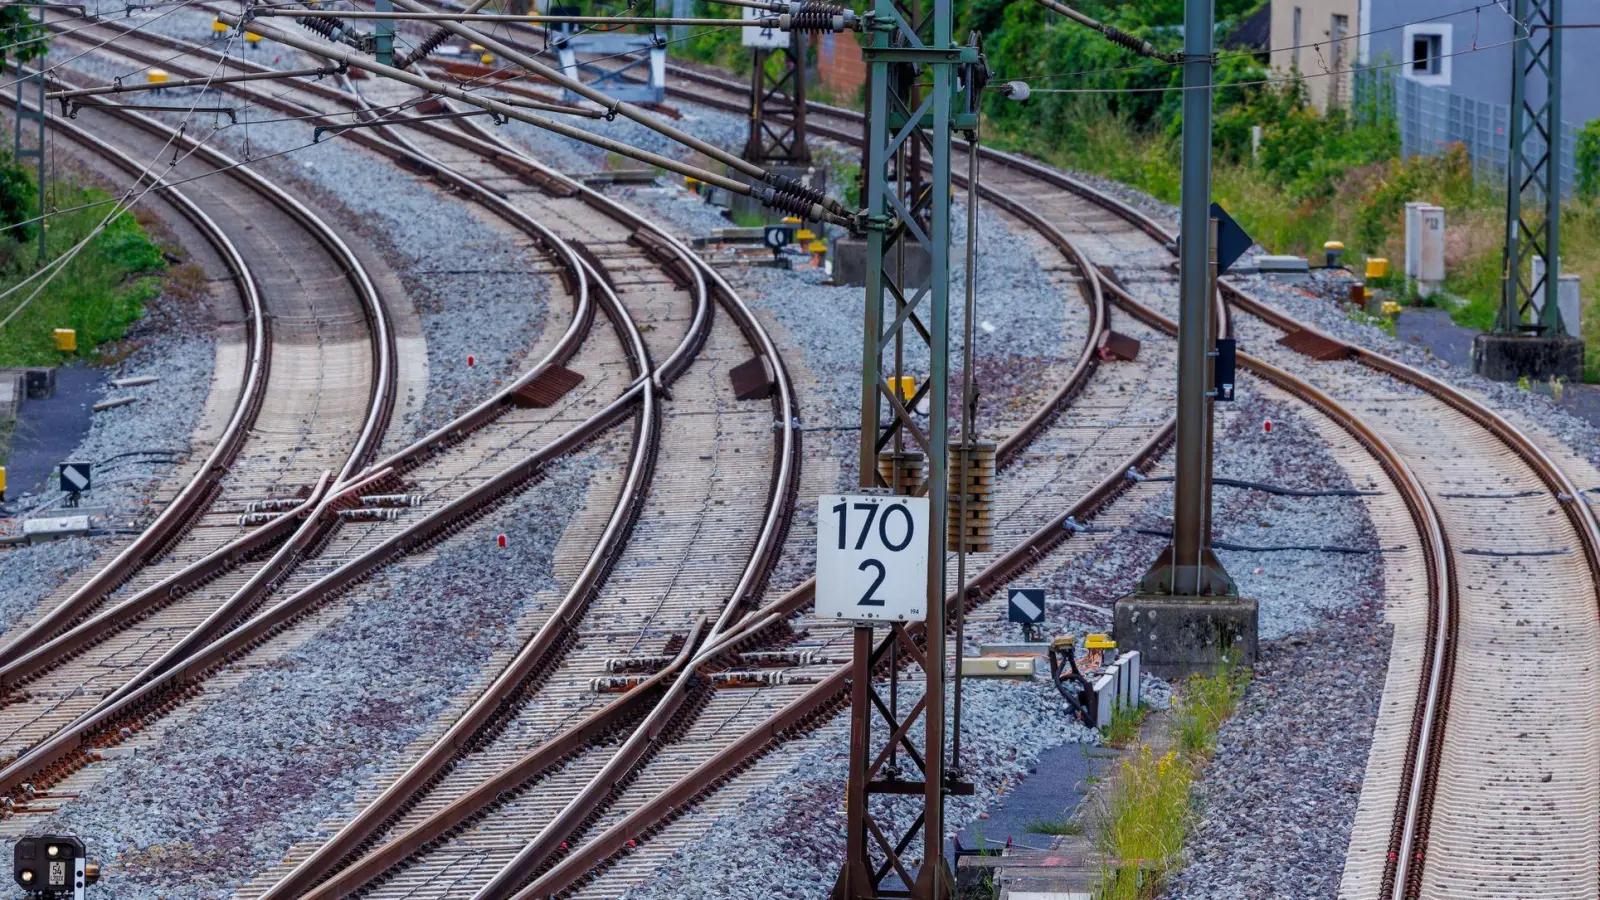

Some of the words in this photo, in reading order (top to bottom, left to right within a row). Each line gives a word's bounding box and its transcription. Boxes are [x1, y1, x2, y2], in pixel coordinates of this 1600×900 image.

[759, 27, 773, 40] 4
[832, 502, 914, 552] 170
[856, 558, 886, 607] 2
[52, 865, 62, 875] 54
